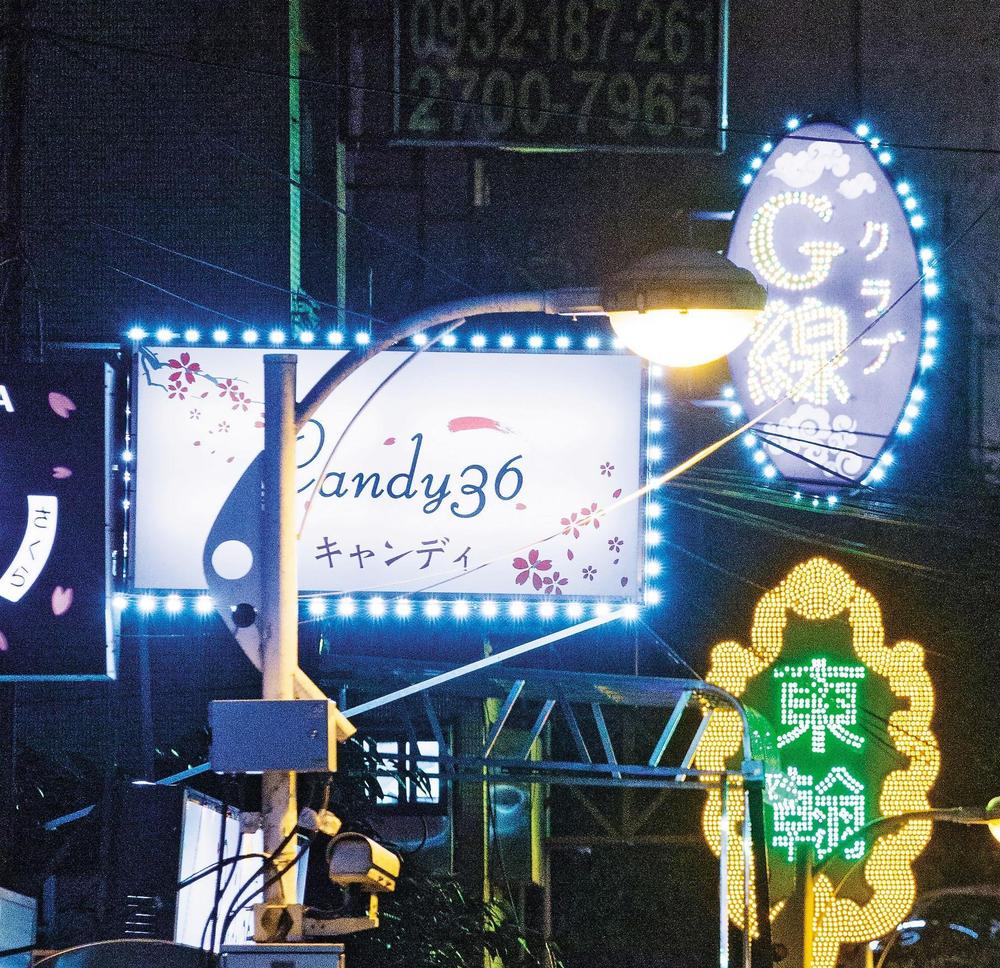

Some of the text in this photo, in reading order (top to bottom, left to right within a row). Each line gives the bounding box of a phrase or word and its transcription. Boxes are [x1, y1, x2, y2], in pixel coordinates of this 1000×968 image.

[408, 66, 711, 138] 2700-7965
[859, 221, 905, 375] クラブ
[315, 536, 472, 571] キャンディ
